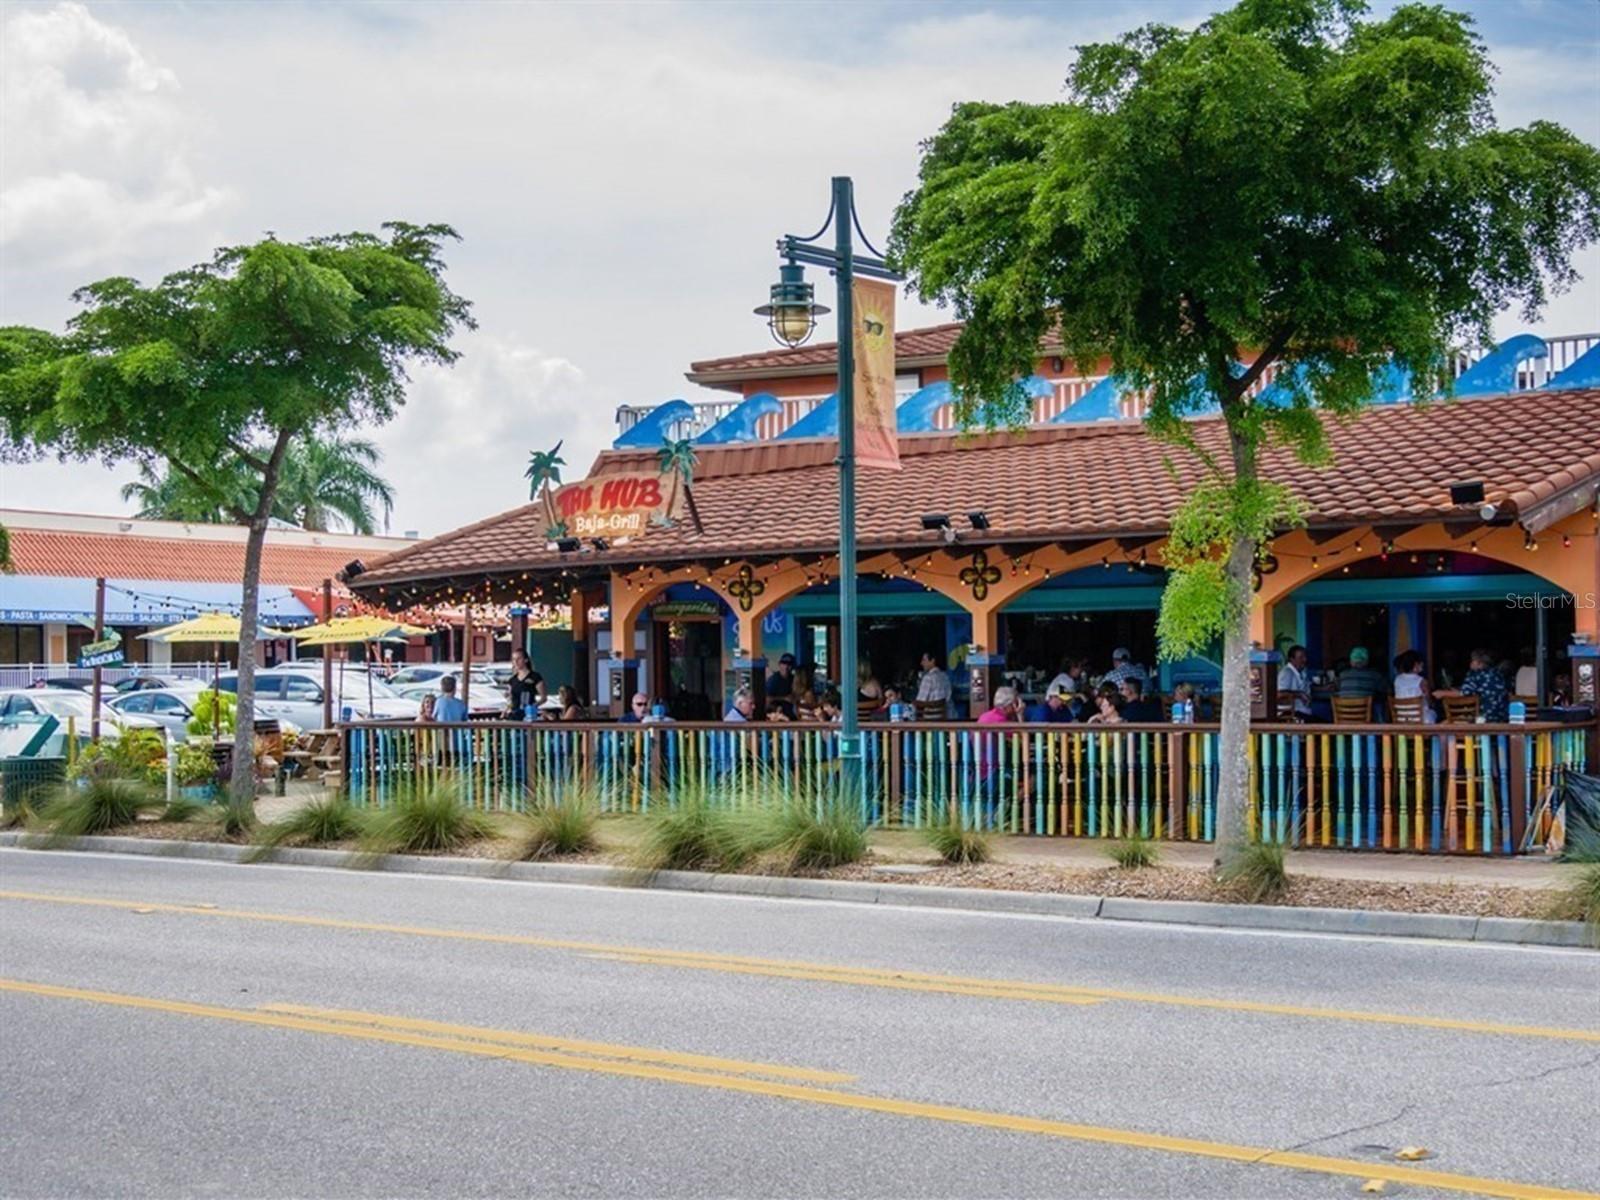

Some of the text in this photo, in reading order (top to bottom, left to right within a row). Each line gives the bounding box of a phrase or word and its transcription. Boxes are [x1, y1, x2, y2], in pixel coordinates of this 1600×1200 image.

[556, 477, 663, 517] THE HUB
[575, 513, 640, 533] Baja-Grill
[11, 611, 33, 621] PASTA
